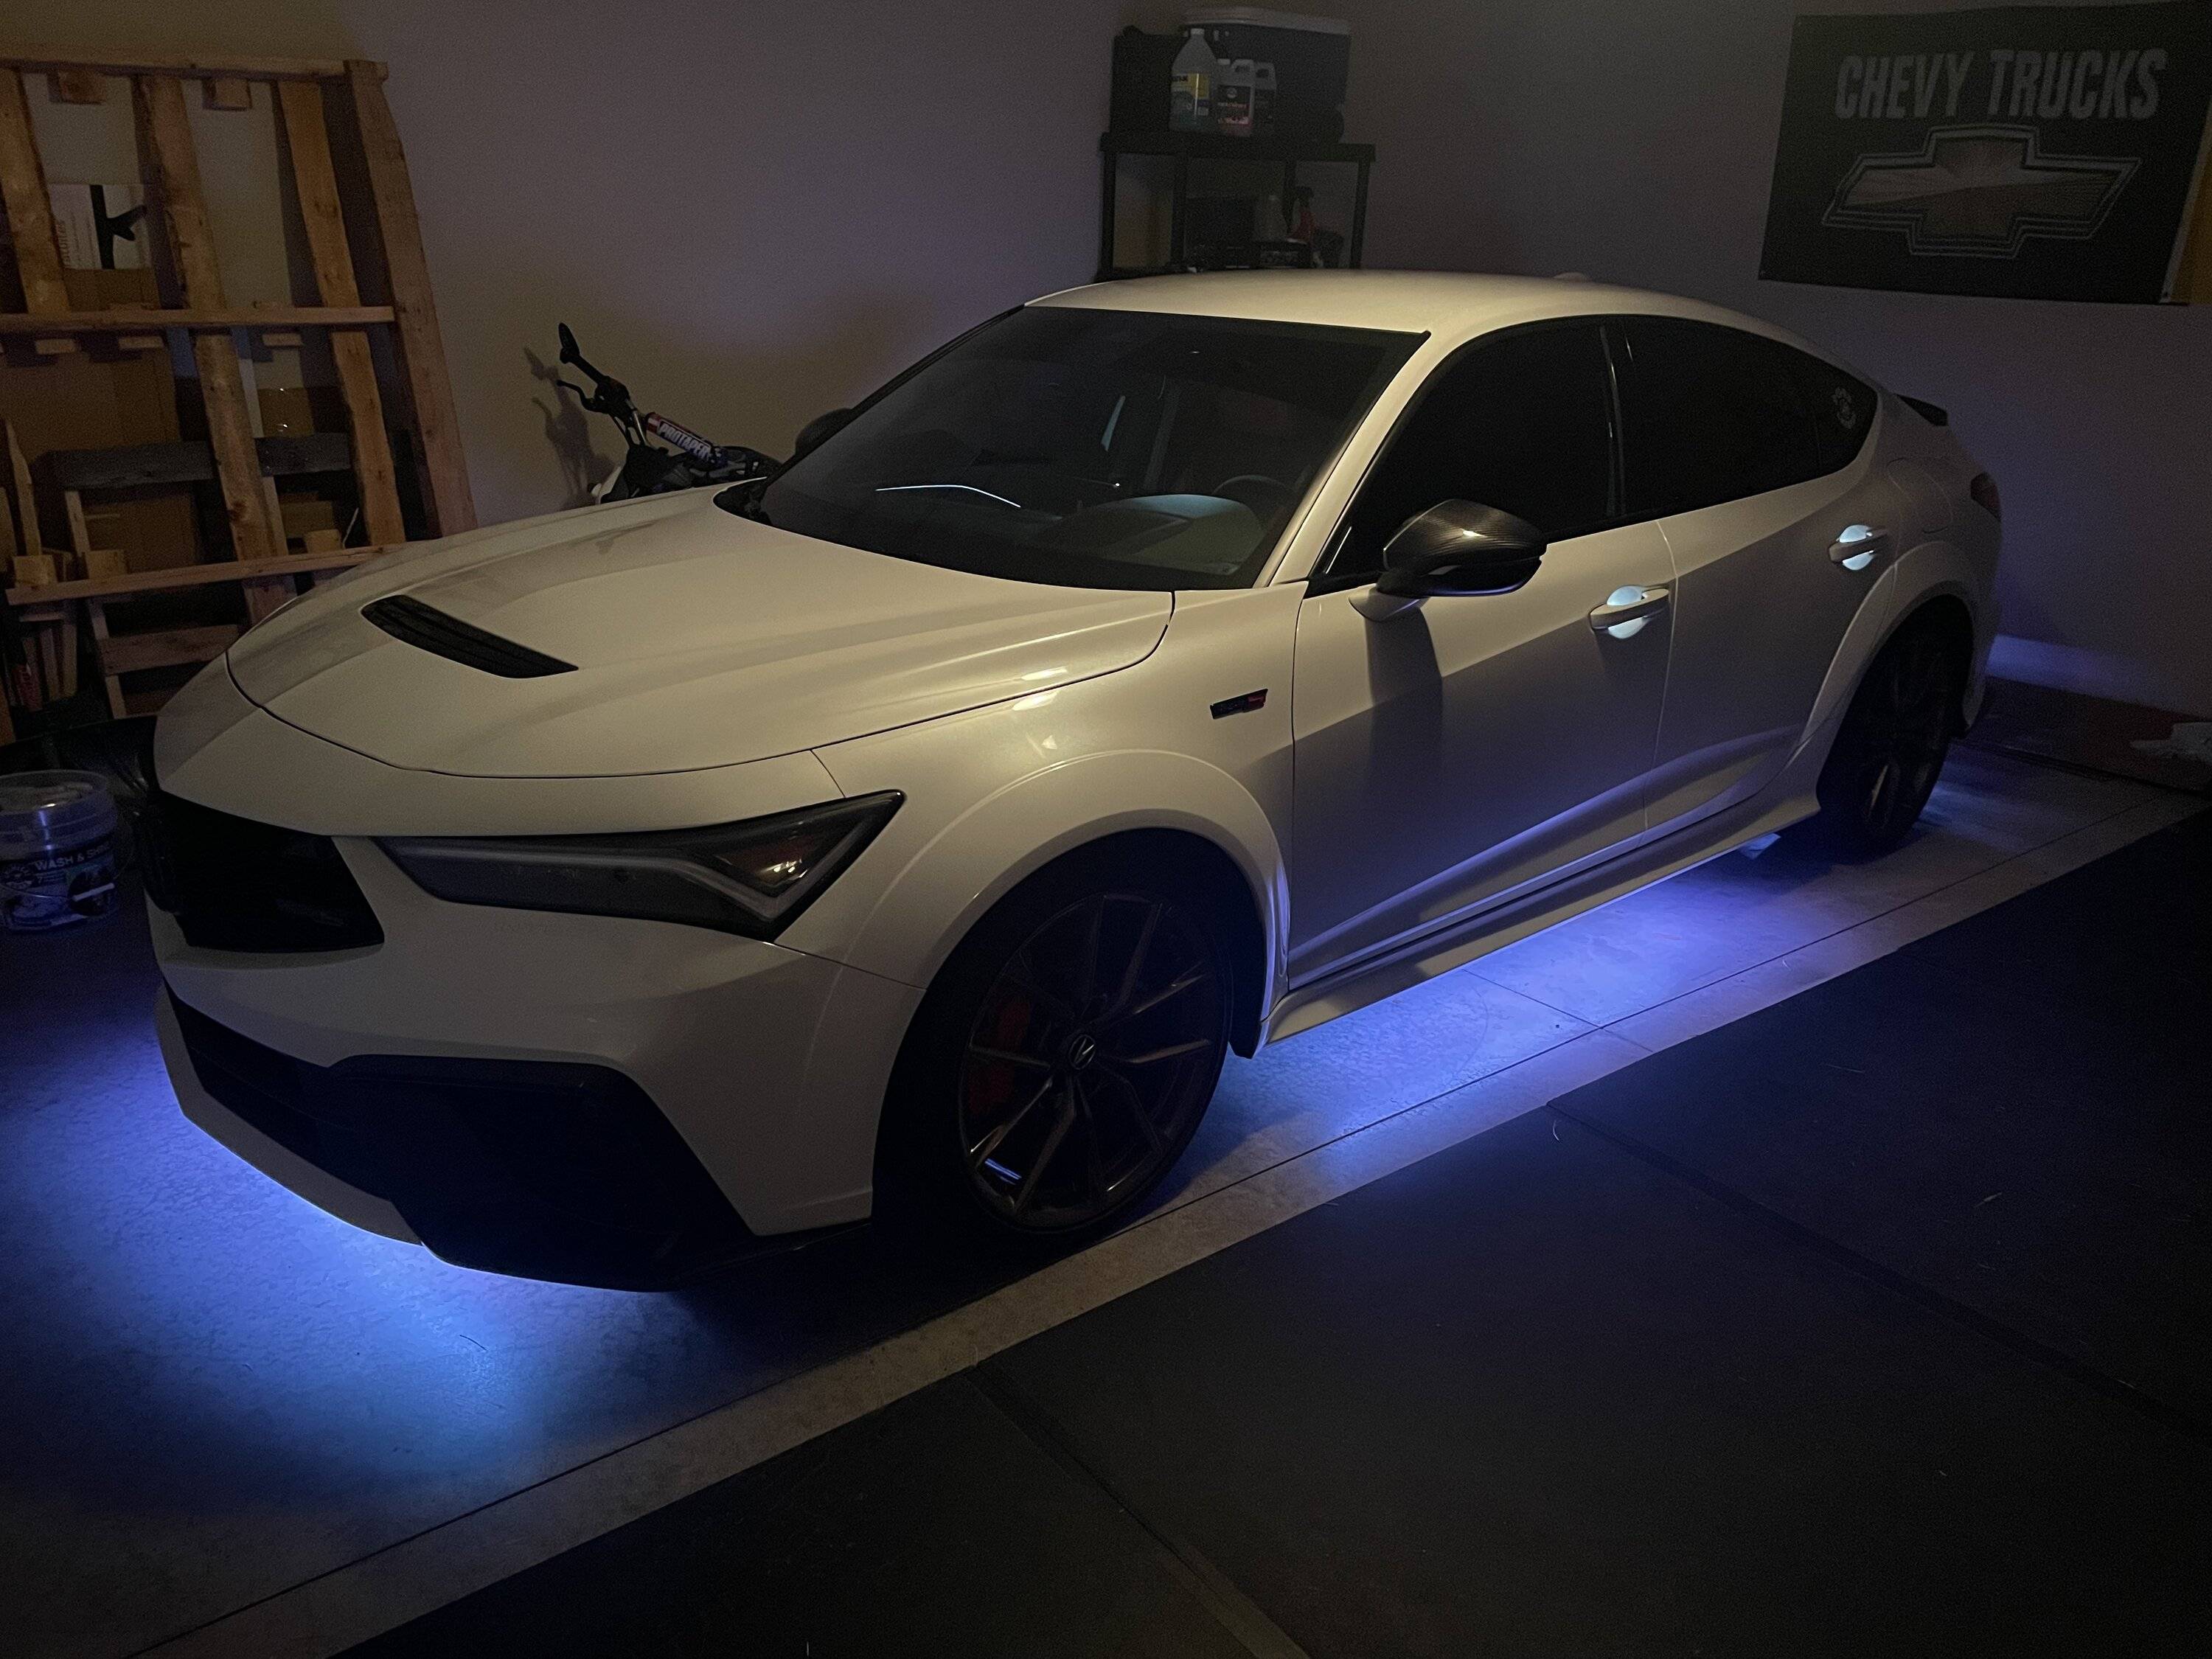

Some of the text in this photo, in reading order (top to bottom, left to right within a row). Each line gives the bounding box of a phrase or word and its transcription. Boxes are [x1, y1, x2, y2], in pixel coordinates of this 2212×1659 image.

[1834, 47, 2169, 119] CHEVY TRUCKS
[659, 422, 709, 461] PROTAPER
[34, 855, 74, 871] WASH
